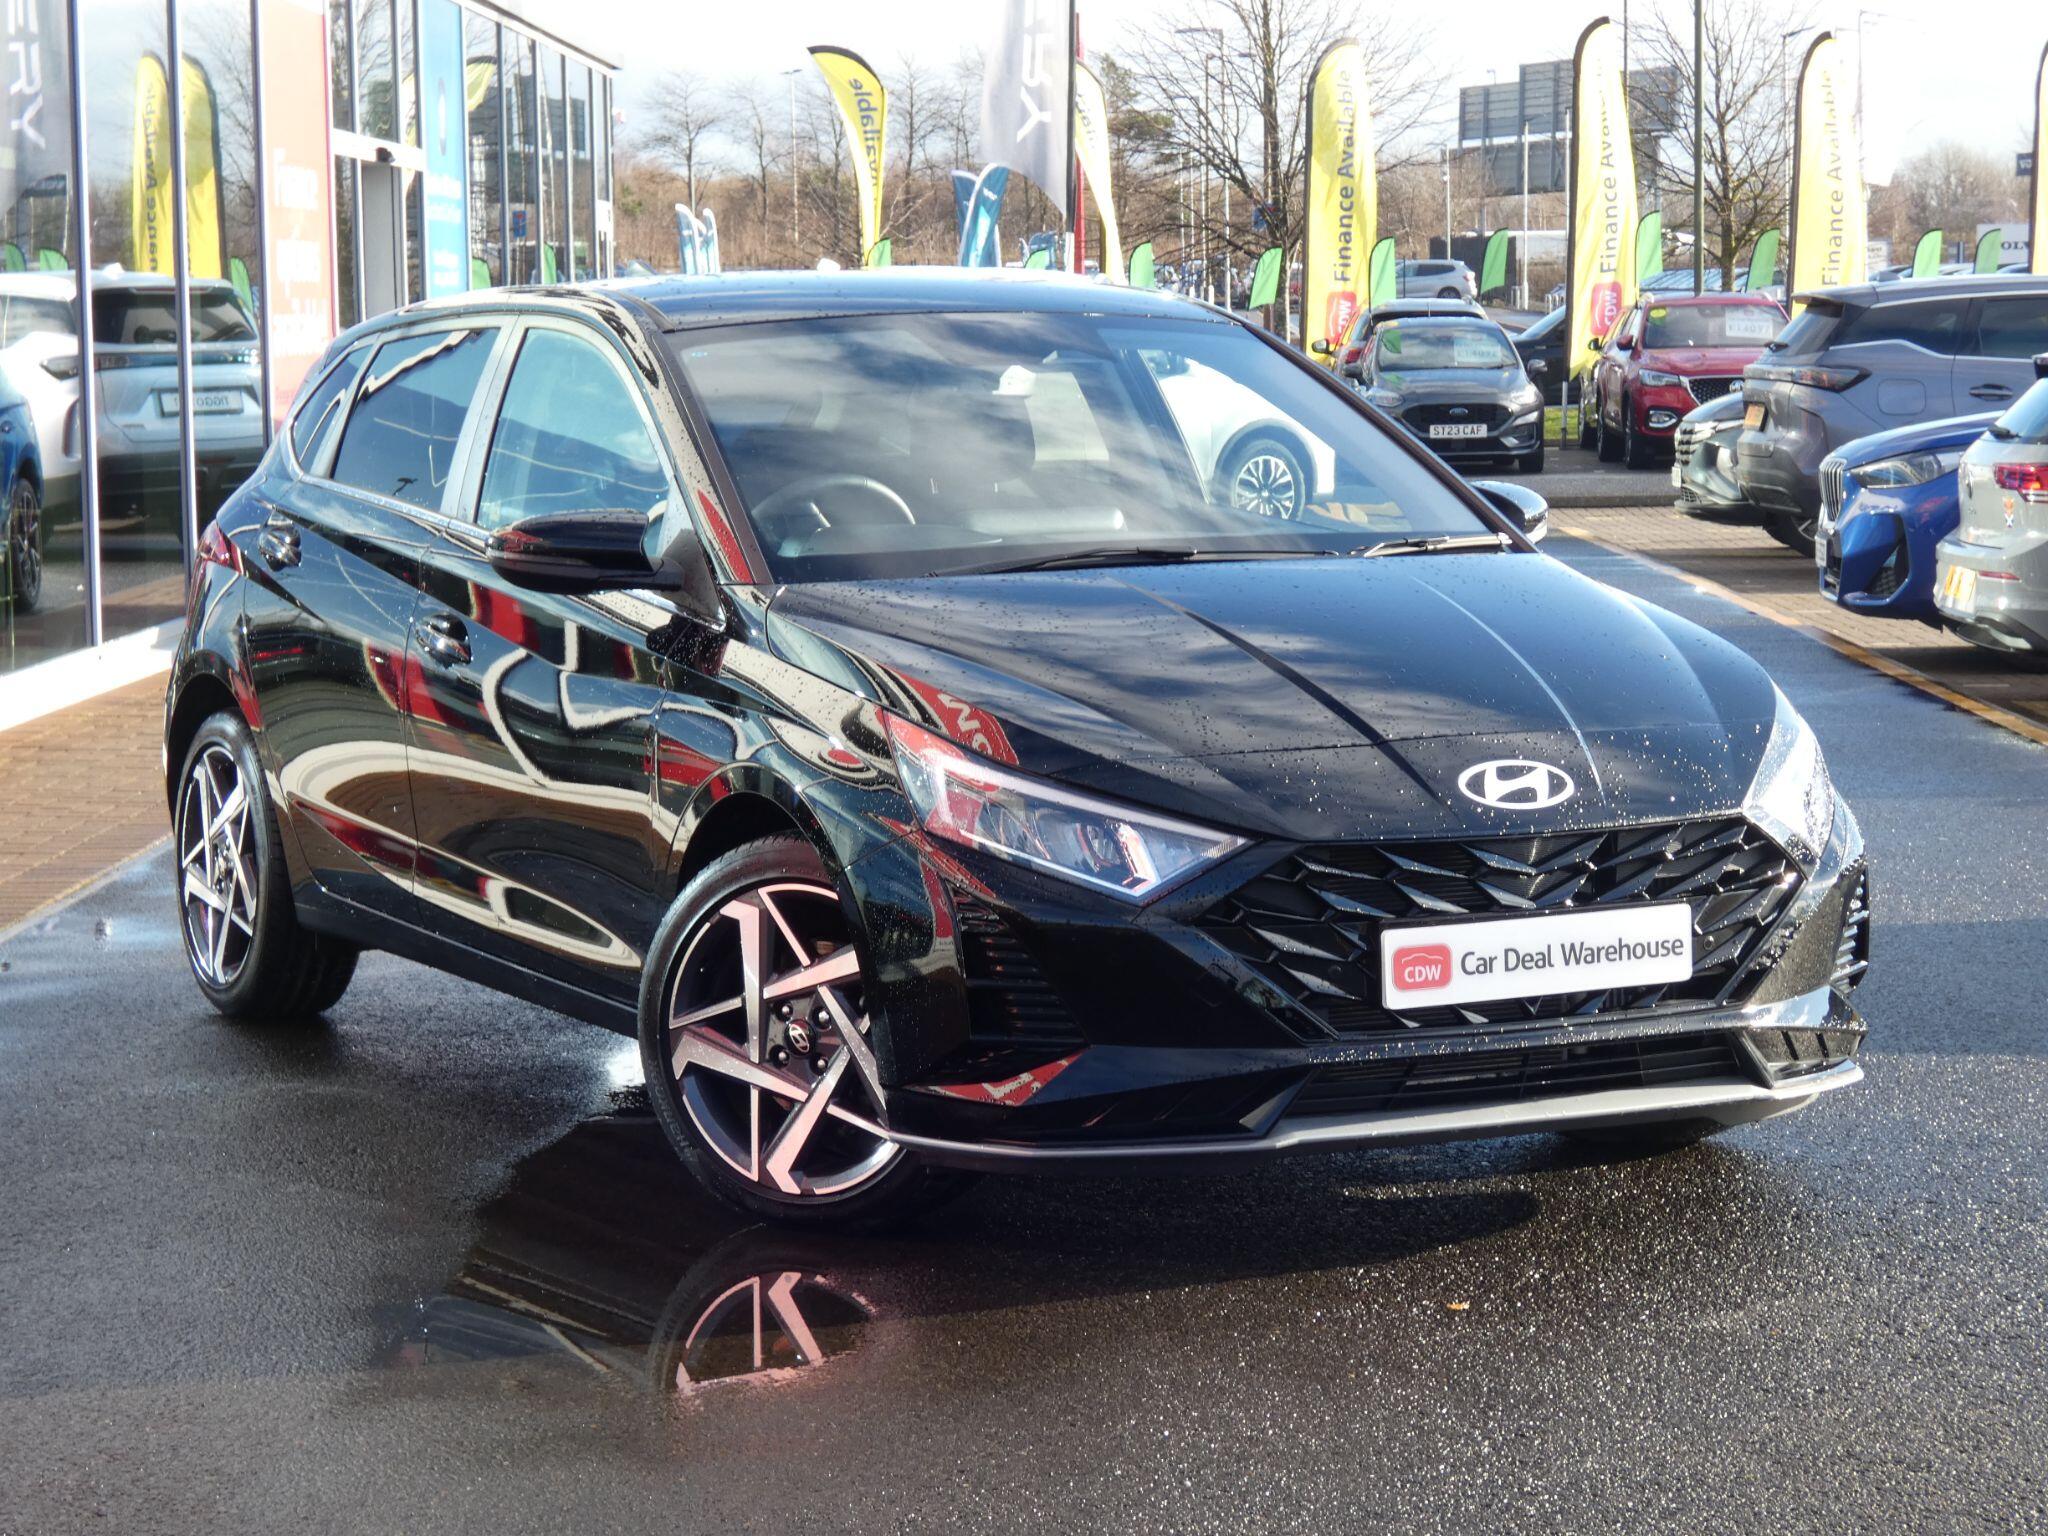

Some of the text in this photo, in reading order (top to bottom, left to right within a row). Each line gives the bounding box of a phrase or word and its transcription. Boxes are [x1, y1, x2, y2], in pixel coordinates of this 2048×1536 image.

[1334, 69, 1355, 282] Finance Available
[1601, 177, 1617, 274] Finance
[1822, 190, 1844, 286] Finance
[1433, 424, 1482, 436] ST23 CAF
[1404, 964, 1442, 984] CDW
[1460, 937, 1685, 976] Car Deal Warehouse
